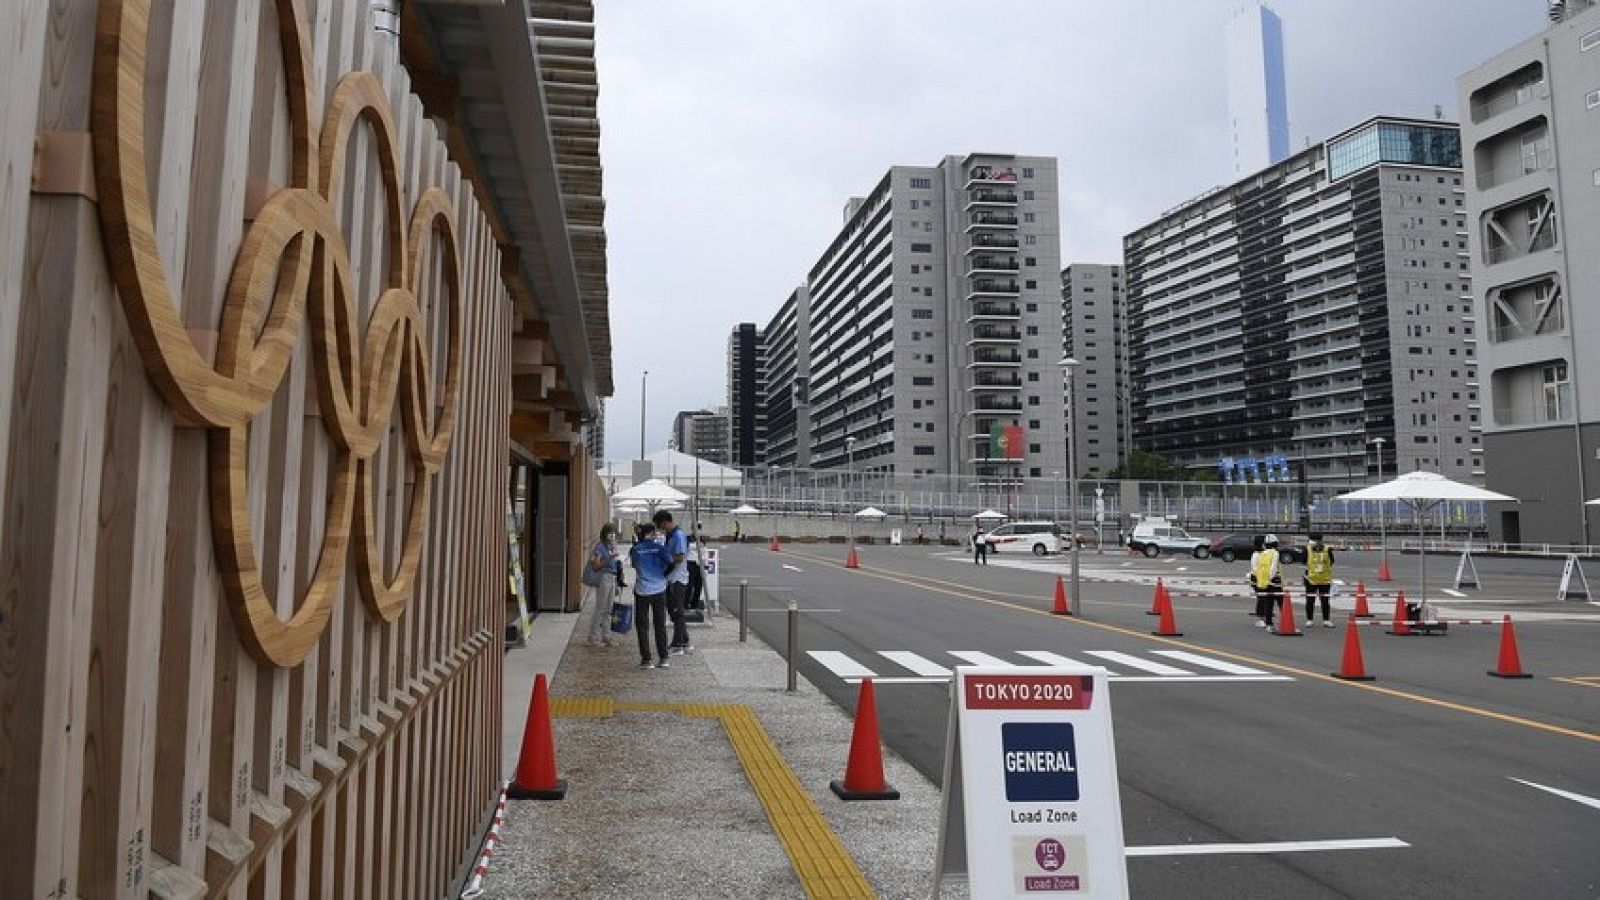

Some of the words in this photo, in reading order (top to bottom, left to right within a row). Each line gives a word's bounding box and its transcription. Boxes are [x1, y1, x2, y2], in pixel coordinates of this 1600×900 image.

[974, 684, 1029, 699] TOKYO
[1033, 684, 1073, 699] 2020
[1006, 751, 1075, 772] GENERAL
[1010, 809, 1042, 823] Load
[1046, 809, 1078, 823] Zone
[1041, 843, 1058, 853] TCT
[1027, 878, 1052, 889] Load
[1054, 877, 1077, 889] Zone
